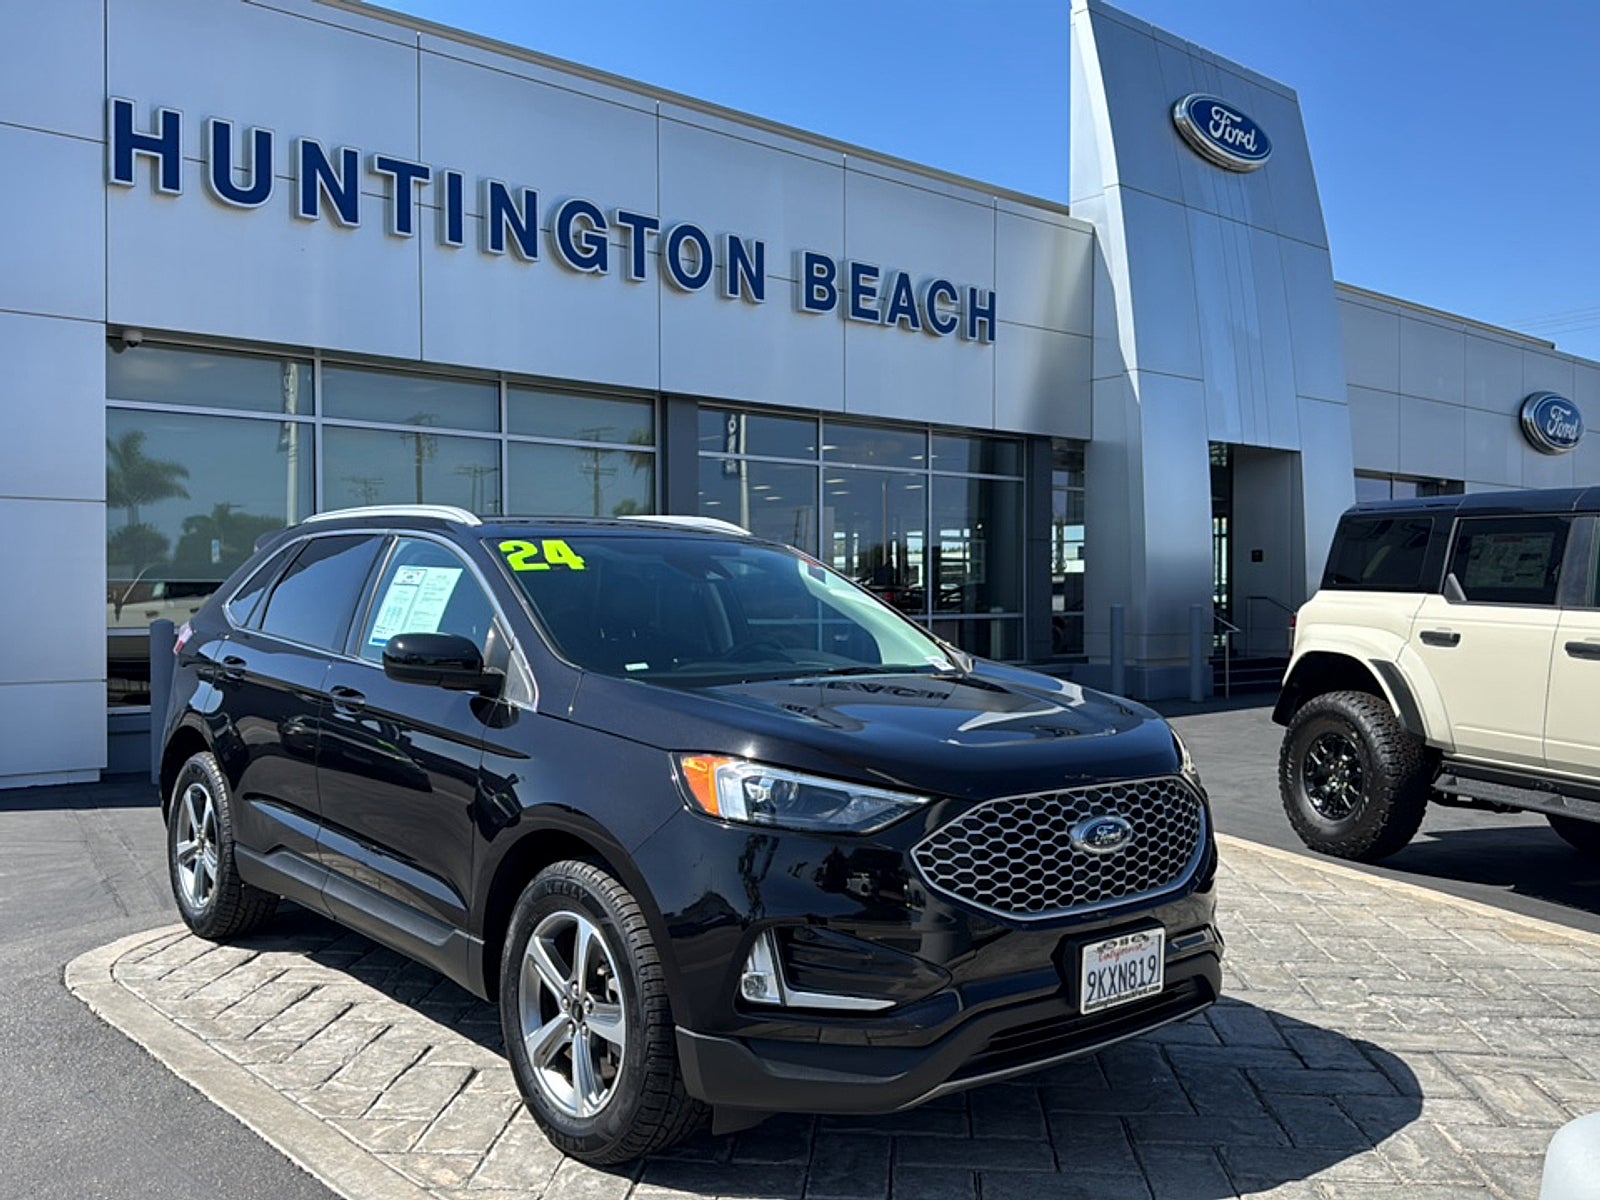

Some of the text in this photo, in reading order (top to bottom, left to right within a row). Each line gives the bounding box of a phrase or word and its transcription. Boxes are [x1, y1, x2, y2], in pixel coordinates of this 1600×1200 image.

[1209, 106, 1258, 152] Ford
[109, 97, 997, 344] HUNTINGTON BEACH
[1547, 405, 1579, 440] Ford
[498, 540, 585, 571] 24
[1086, 955, 1157, 1003] 9KXN819
